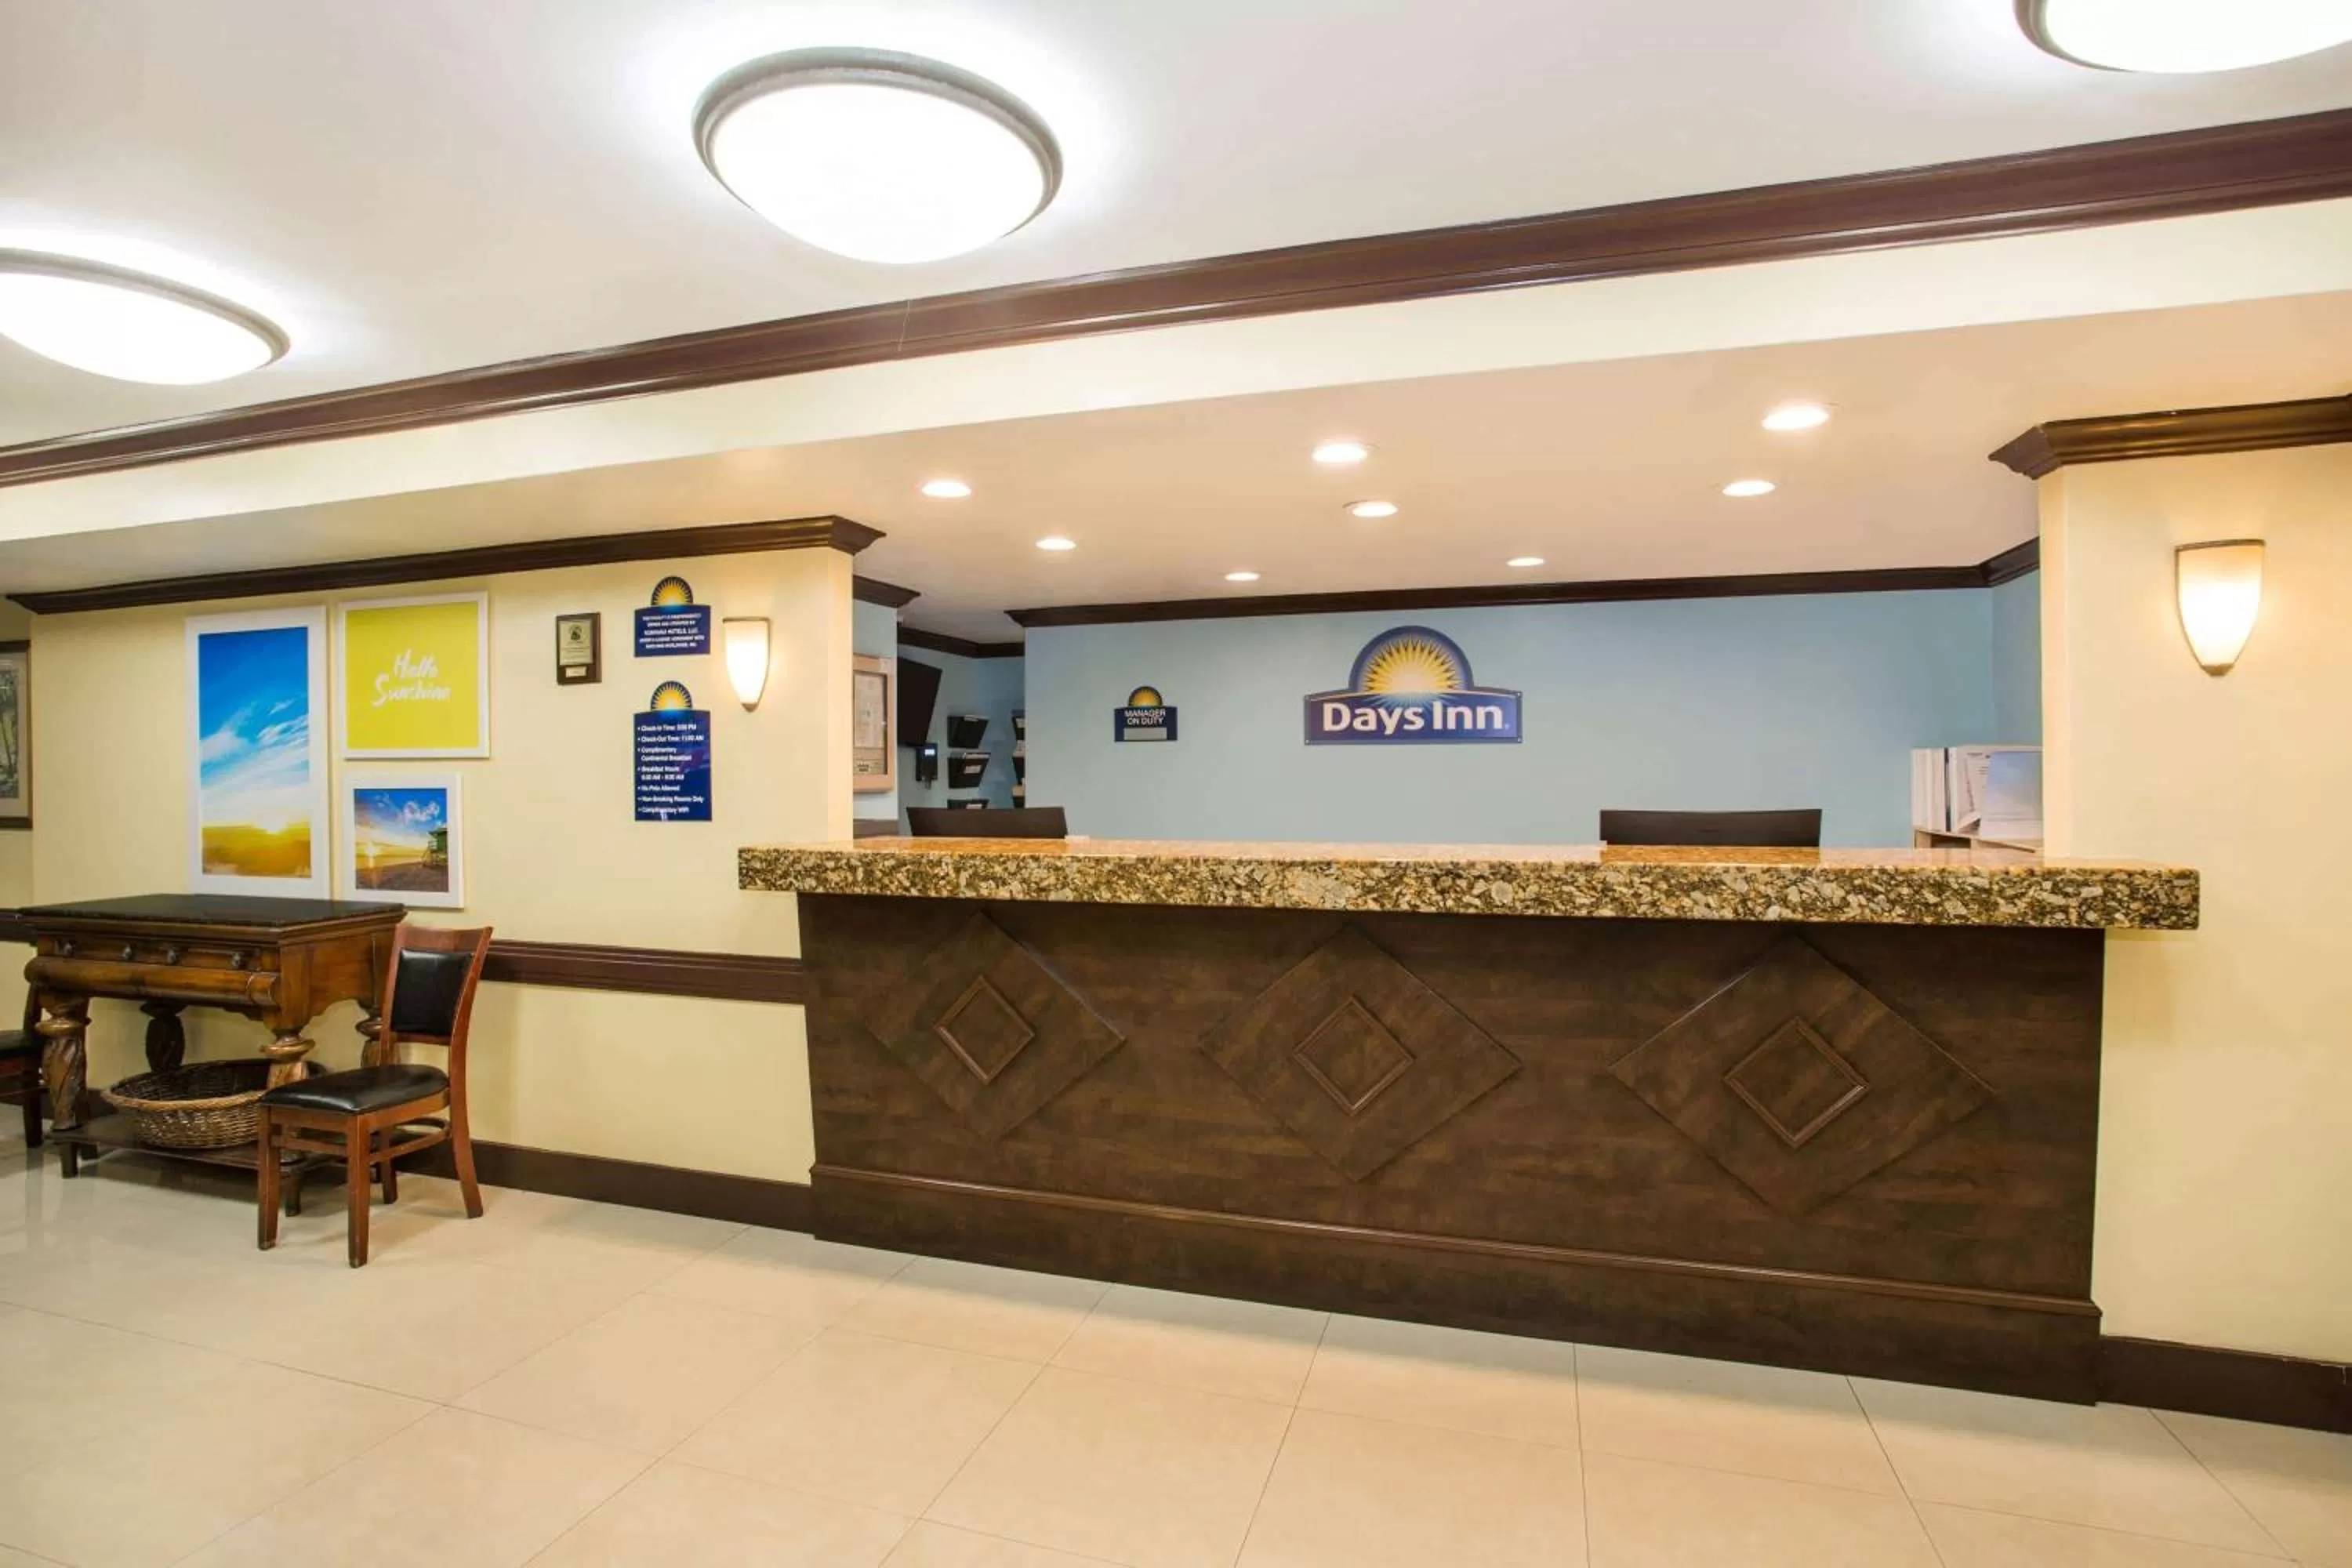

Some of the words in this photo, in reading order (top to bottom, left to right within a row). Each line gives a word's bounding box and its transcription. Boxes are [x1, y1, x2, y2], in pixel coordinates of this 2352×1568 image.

[393, 649, 438, 679] Hello
[371, 672, 452, 706] Sunshine
[1124, 708, 1166, 717] MANAGER
[1323, 702, 1425, 735] Days
[1432, 702, 1504, 730] Inn
